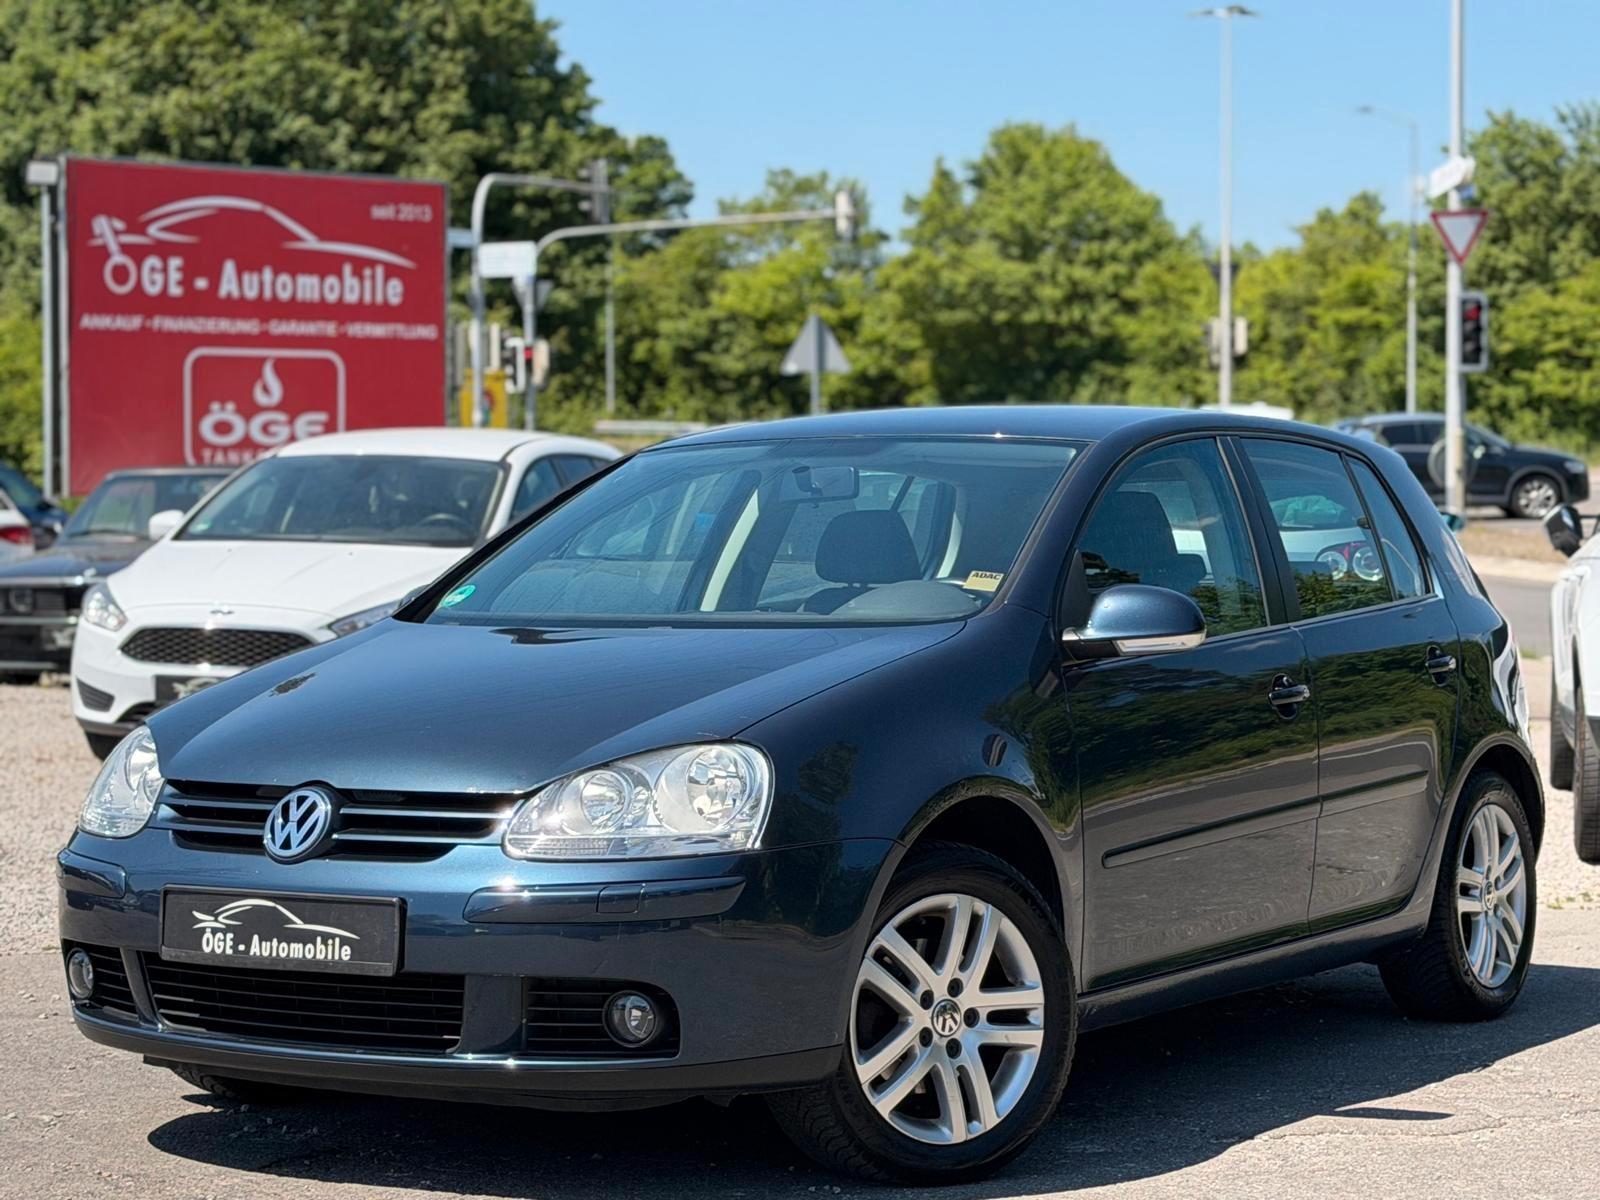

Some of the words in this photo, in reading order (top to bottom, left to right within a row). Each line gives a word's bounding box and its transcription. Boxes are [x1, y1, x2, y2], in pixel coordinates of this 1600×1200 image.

[217, 258, 405, 307] Automobile
[79, 312, 145, 332] ANKAUF
[199, 401, 330, 446] ÖGE
[971, 572, 1001, 580] ADAC
[202, 927, 234, 955] ÖGE
[249, 933, 352, 961] Automobile
